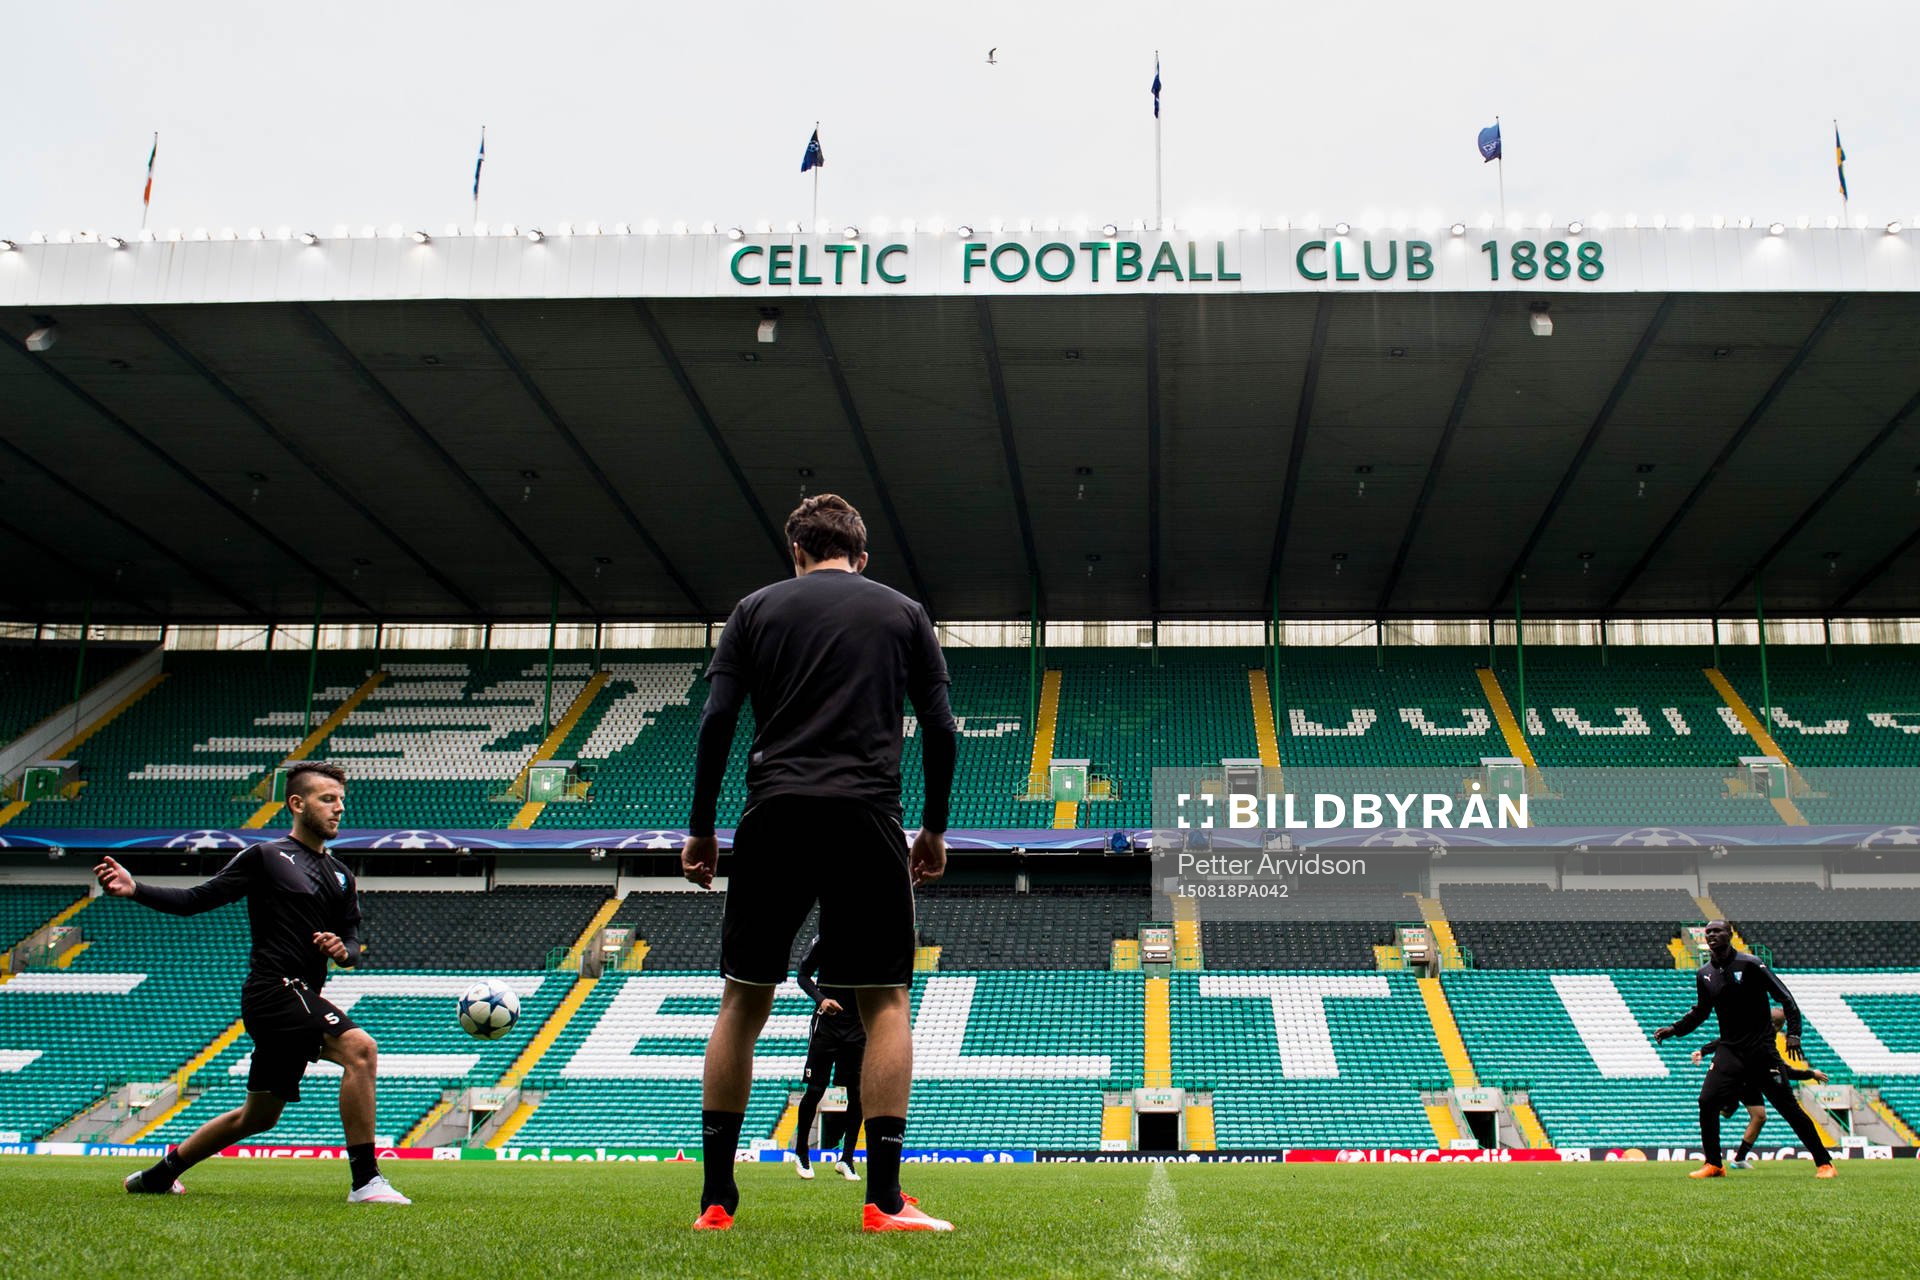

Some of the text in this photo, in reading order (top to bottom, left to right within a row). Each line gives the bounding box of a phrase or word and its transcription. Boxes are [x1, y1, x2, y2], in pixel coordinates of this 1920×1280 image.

[729, 240, 1605, 285] CELTIC FOOTBALL CLUB 1888
[324, 1012, 340, 1025] 5
